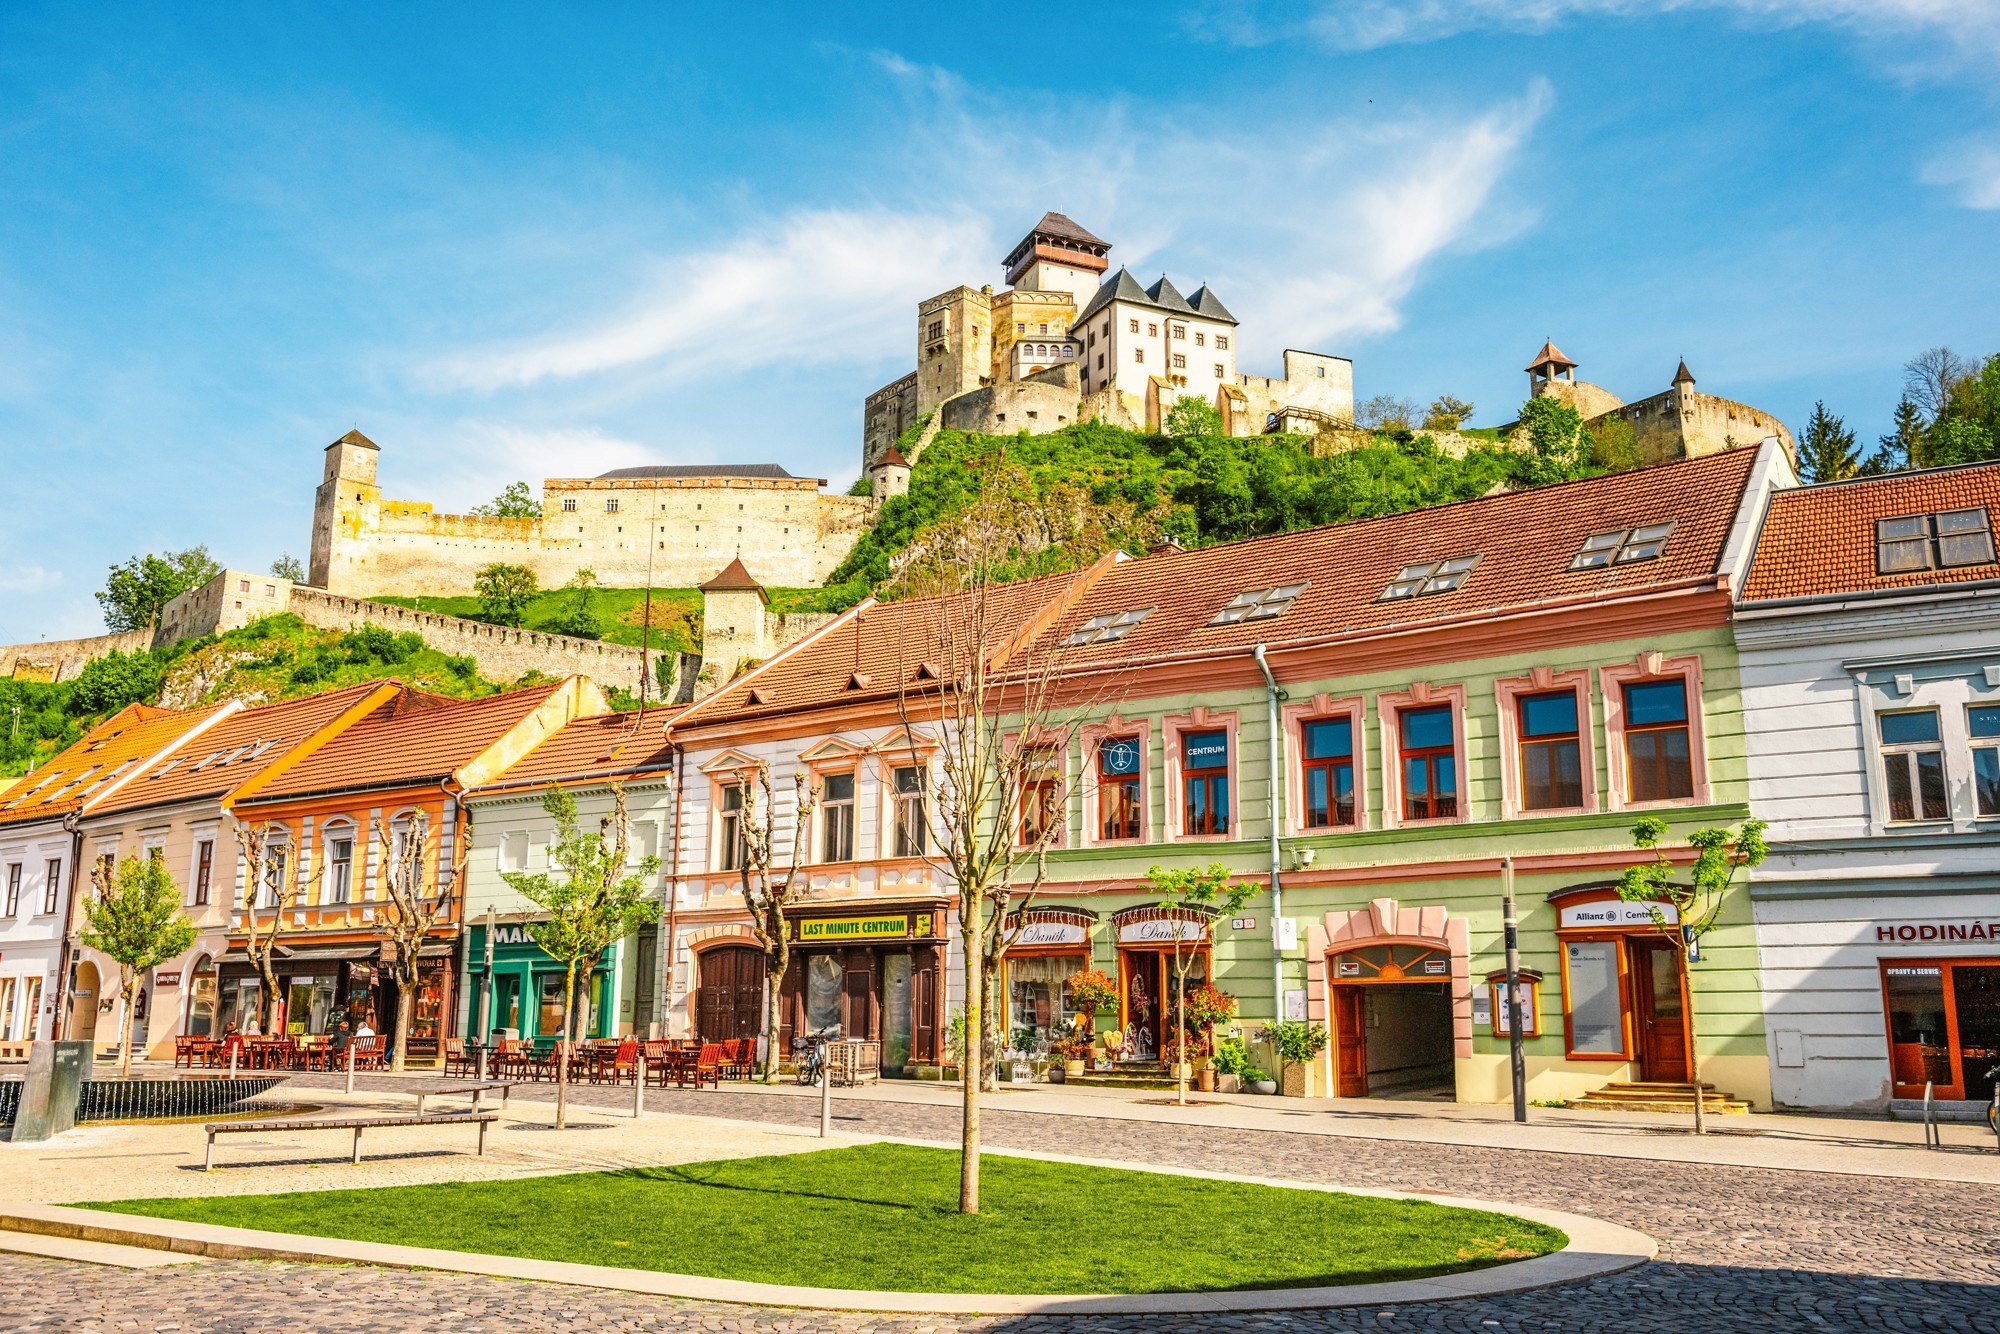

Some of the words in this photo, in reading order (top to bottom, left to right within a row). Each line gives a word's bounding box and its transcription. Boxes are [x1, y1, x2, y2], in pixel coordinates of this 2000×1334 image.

[1188, 745, 1225, 756] CENTRUM
[1025, 759, 1058, 770] EMNI
[1576, 912, 1605, 921] Allianz
[1625, 911, 1663, 919] Centrm
[803, 923, 824, 935] LAST
[825, 922, 860, 934] MINUTE
[862, 920, 905, 933] CENTRUM
